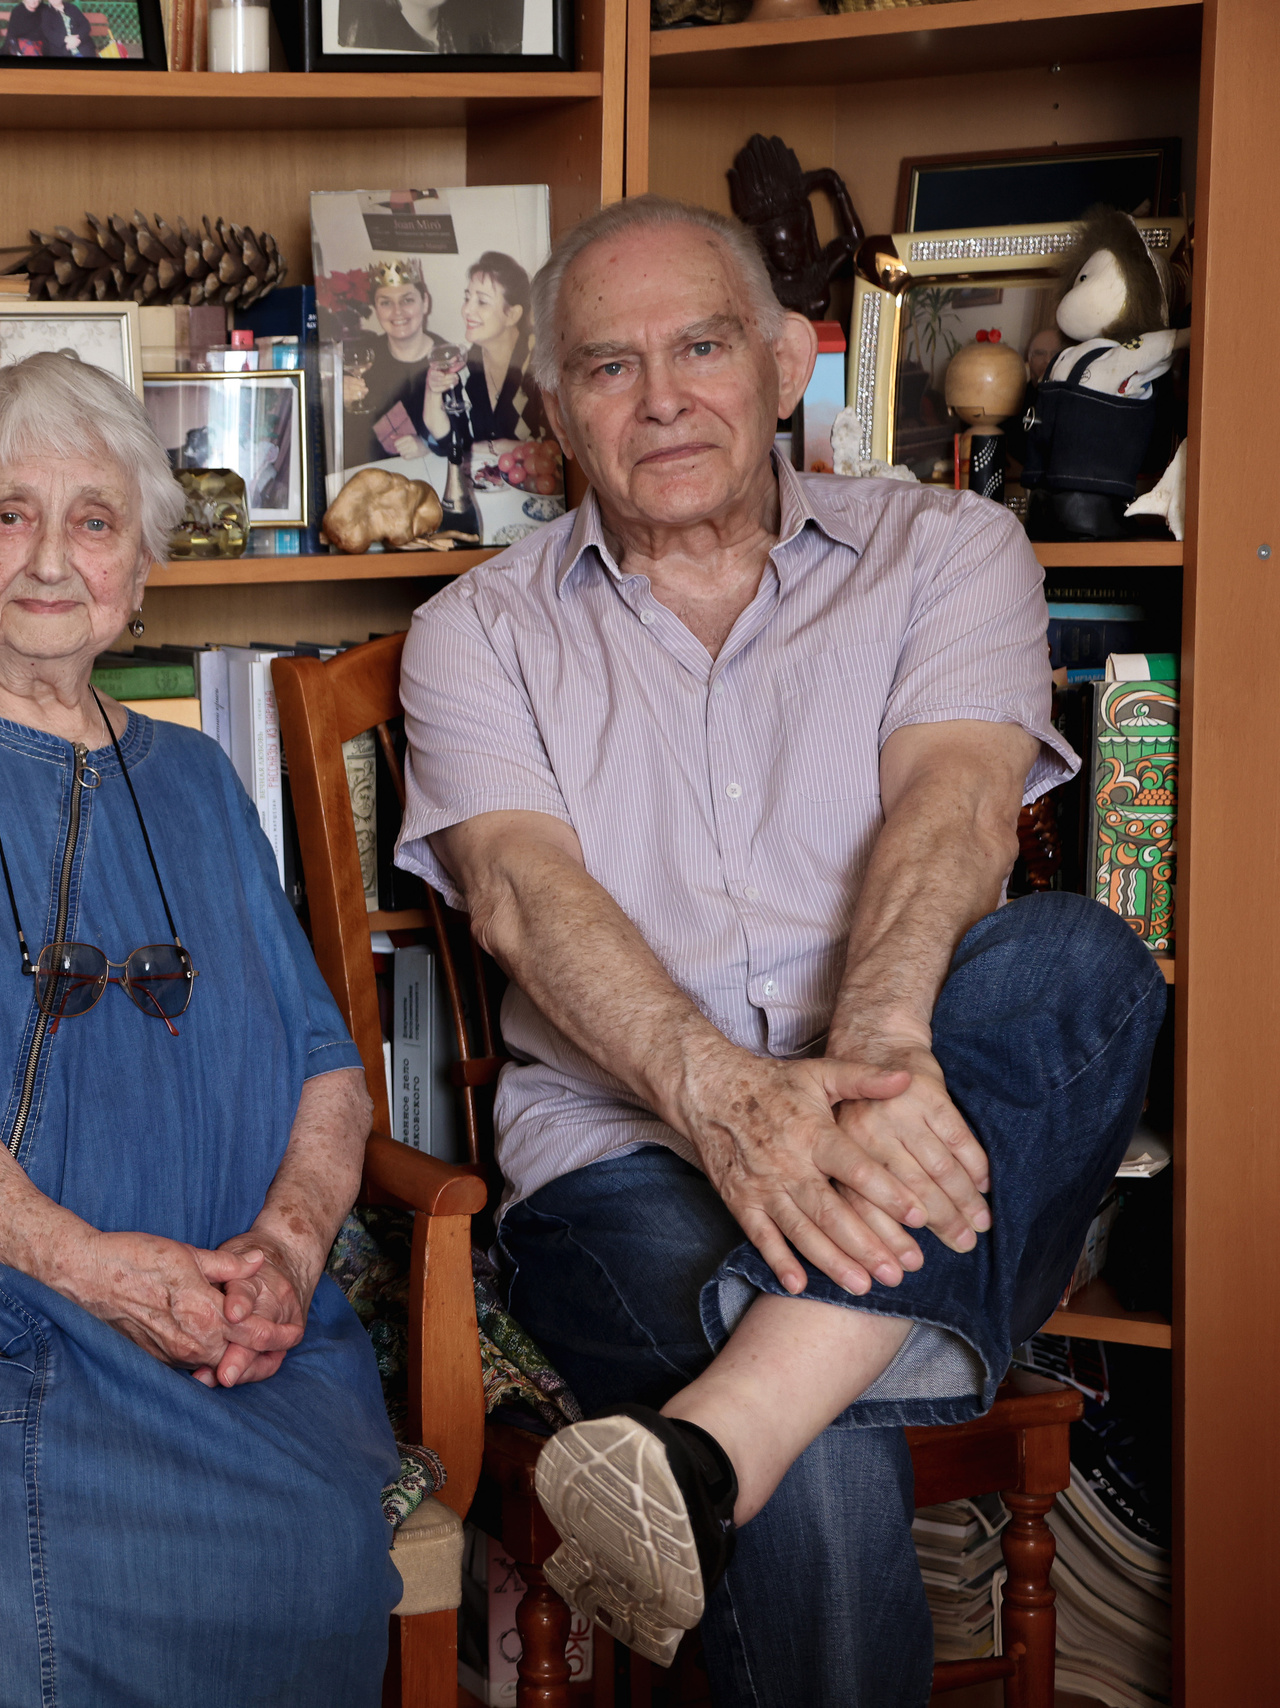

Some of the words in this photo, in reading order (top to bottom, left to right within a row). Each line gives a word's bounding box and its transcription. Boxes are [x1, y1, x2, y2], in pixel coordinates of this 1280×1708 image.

[264, 688, 277, 720] ПАРИЖА
[256, 730, 266, 766] ЛЮБОВЬ
[266, 726, 277, 739] ИЗ
[258, 767, 268, 800] ВЕЧНАЯ
[267, 743, 280, 789] РАССКАЗЫ
[402, 1056, 411, 1091] дело
[1091, 1465, 1121, 1492] ВСЕ
[1115, 1494, 1140, 1521] ЗА
